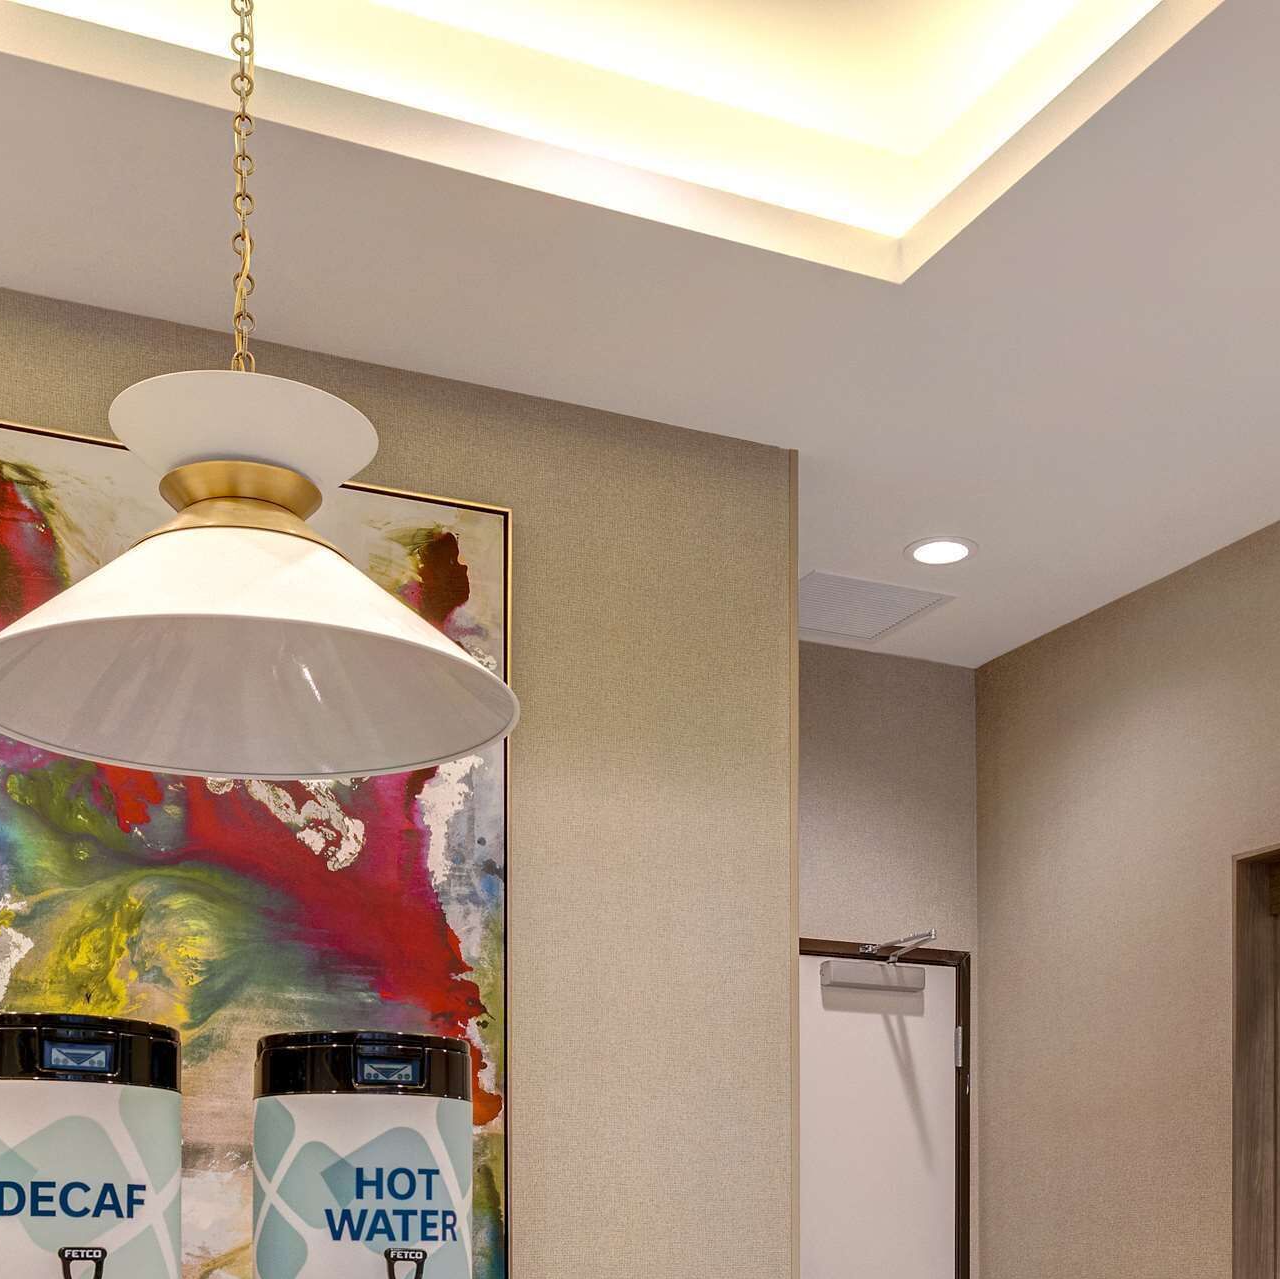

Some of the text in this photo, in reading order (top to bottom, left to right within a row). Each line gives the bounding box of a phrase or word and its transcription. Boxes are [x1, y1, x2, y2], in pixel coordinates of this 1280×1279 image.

[355, 1167, 440, 1201] HOT
[324, 1208, 458, 1242] WATER
[64, 1249, 102, 1258] FETCO
[390, 1250, 423, 1259] FETCO
